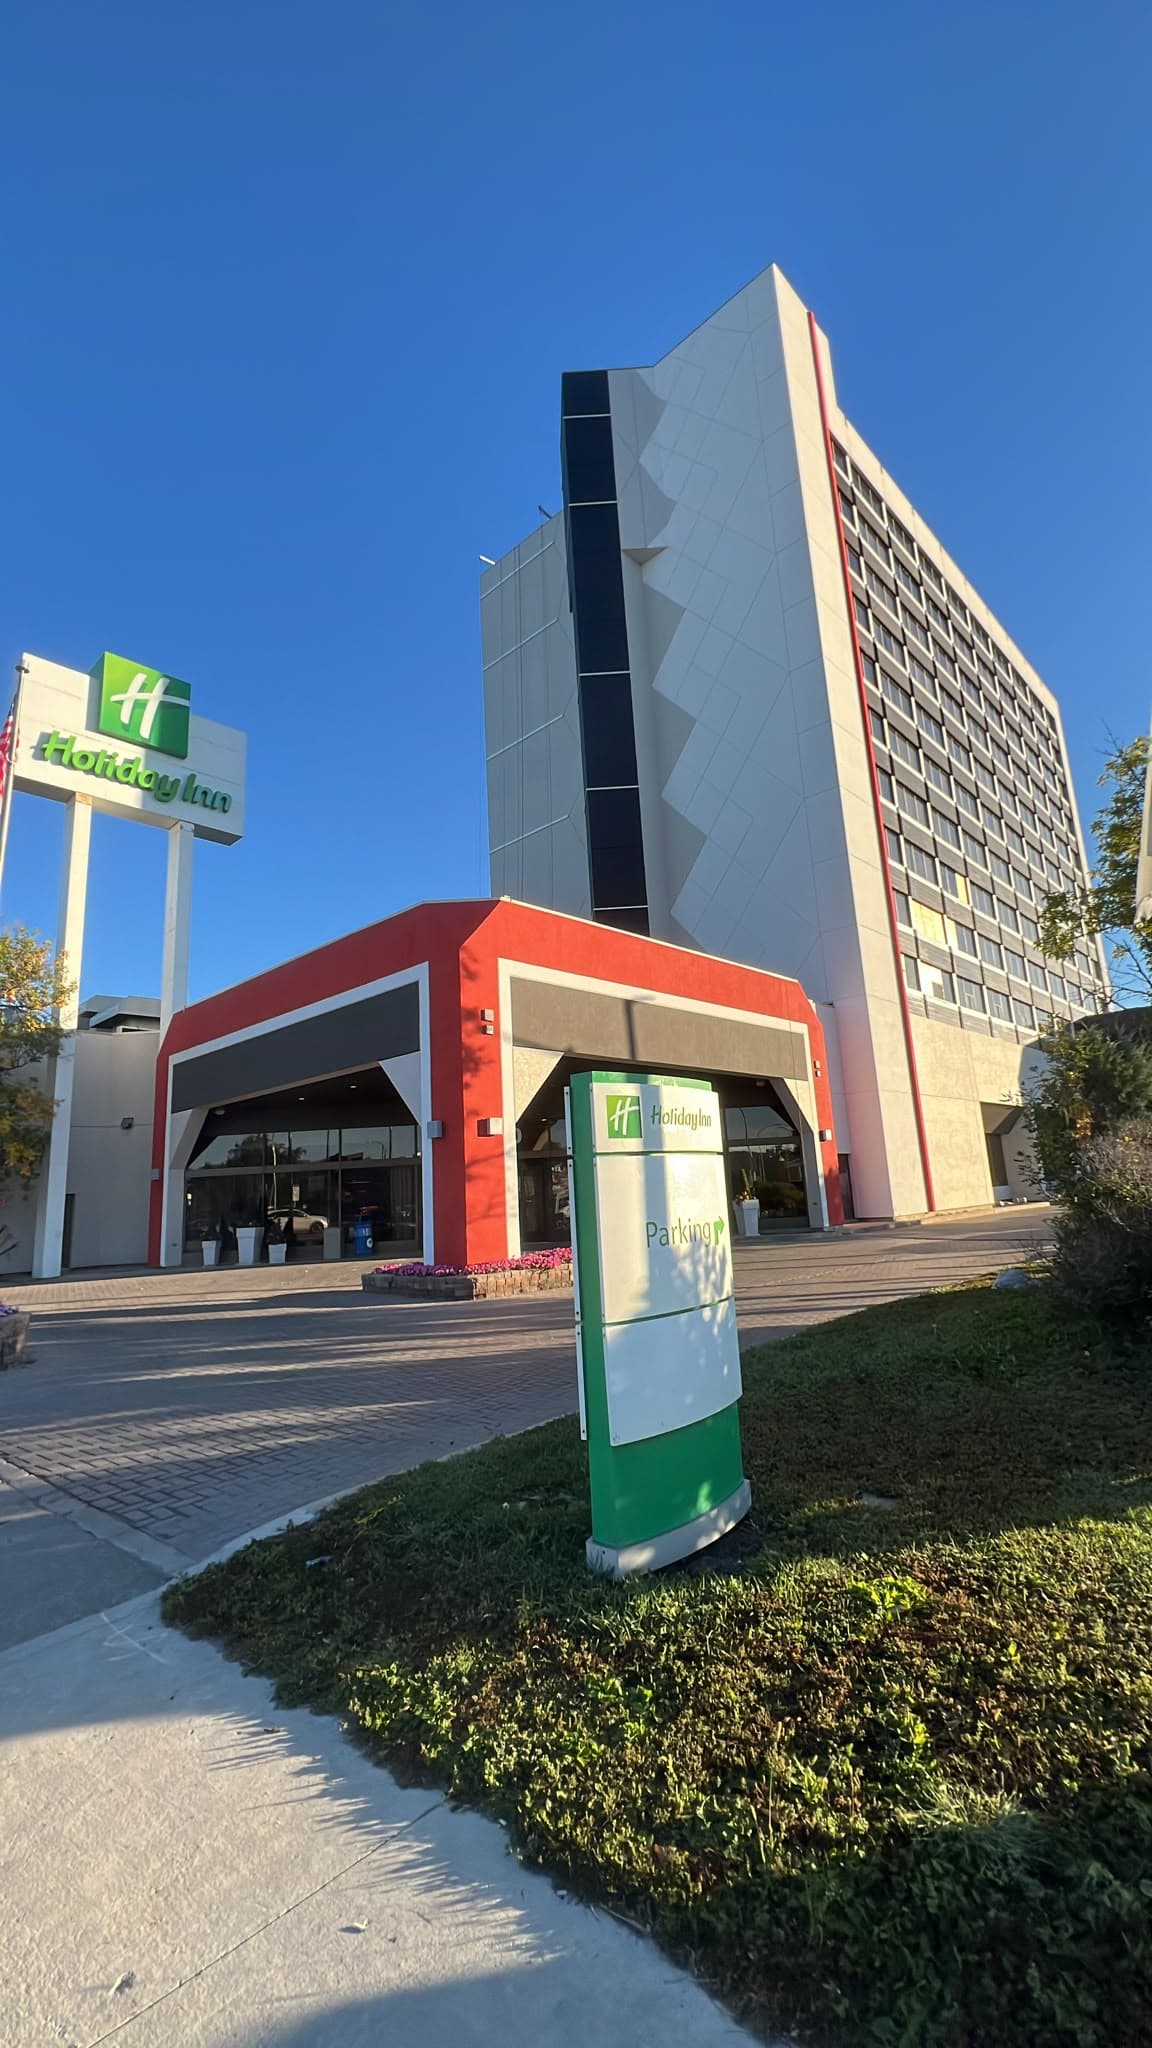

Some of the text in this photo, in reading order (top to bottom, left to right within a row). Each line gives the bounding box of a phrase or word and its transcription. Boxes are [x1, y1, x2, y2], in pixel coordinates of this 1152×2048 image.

[42, 730, 233, 813] Holiday Inn
[650, 1104, 712, 1131] Holiday Inn
[645, 1217, 712, 1249] Parking
